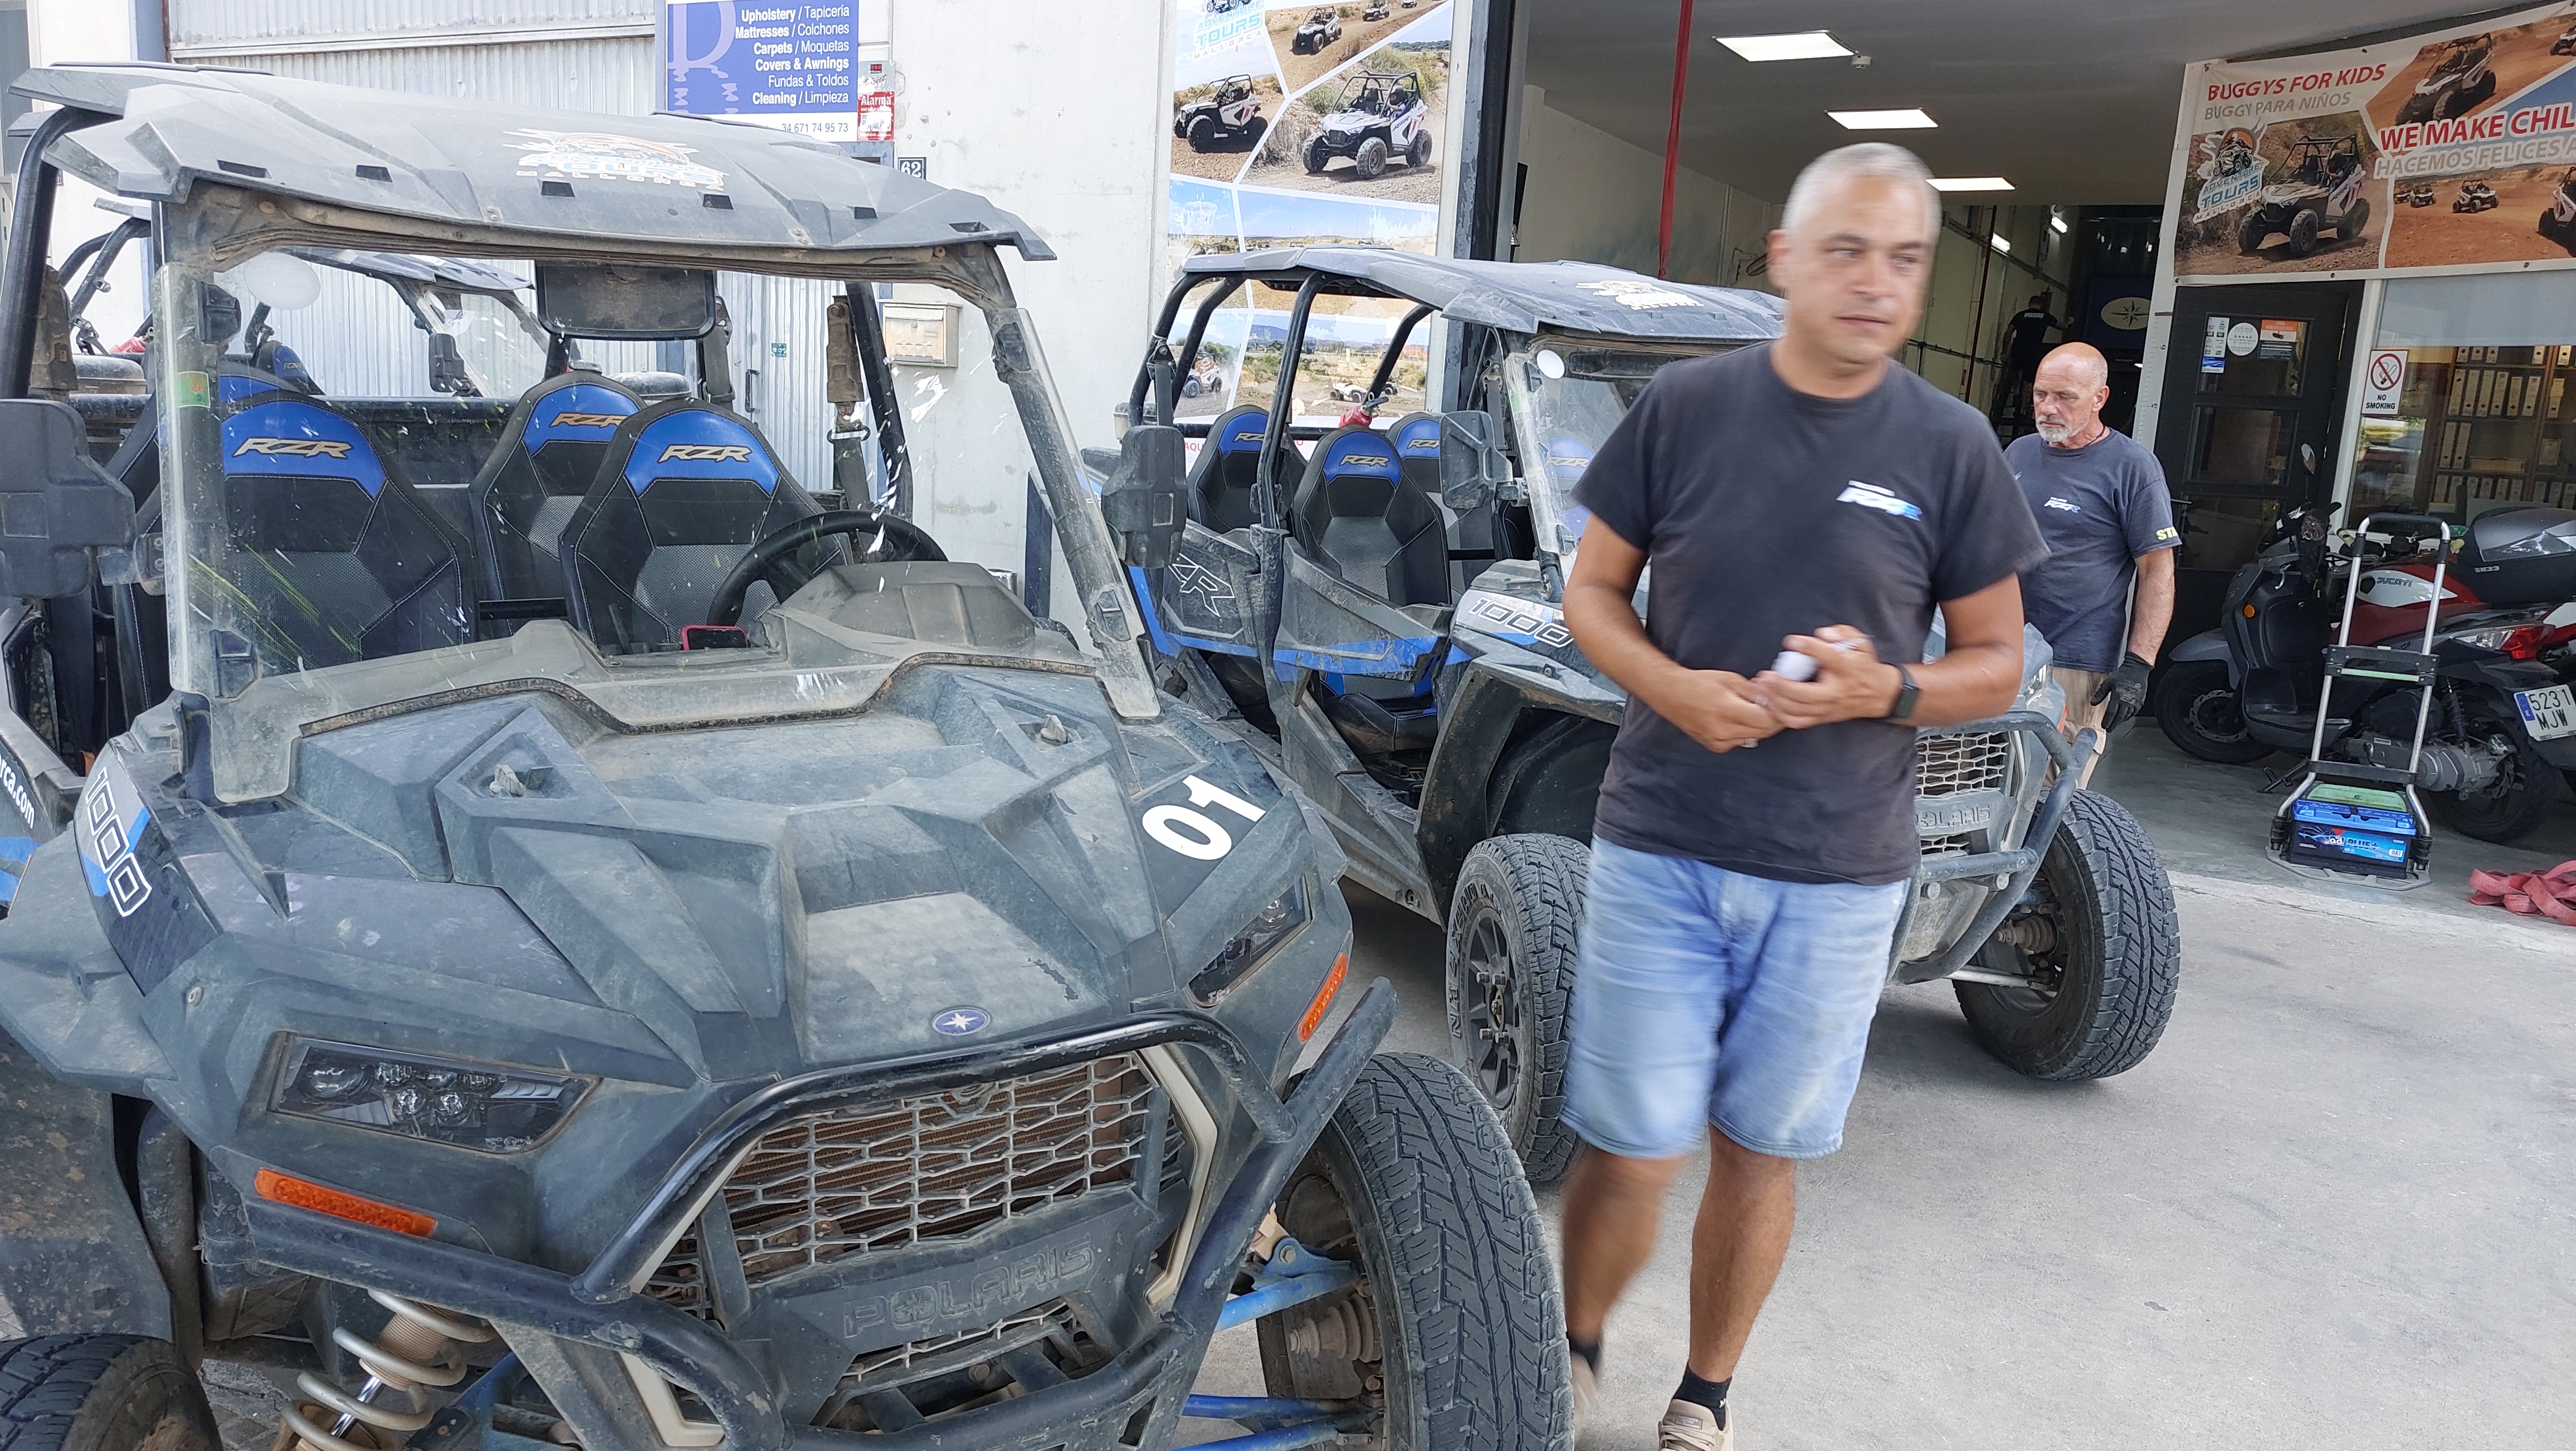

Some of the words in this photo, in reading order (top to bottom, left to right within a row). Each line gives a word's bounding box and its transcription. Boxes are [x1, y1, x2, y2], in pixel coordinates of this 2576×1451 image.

[741, 7, 796, 25] Upholstery
[798, 5, 803, 21] /
[804, 3, 850, 21] Tapicería
[735, 27, 789, 39] Mattresses
[792, 23, 796, 37] /
[798, 23, 850, 36] Colchones
[1197, 12, 1263, 48] TOURS
[754, 41, 793, 57] Carpets
[795, 40, 799, 55] /
[801, 40, 850, 55] Moquetas
[1194, 30, 1261, 60] MALLORCA
[755, 59, 791, 71] Covers
[793, 57, 802, 70] &
[804, 56, 849, 72] Awnings
[768, 74, 804, 88] Fundas
[806, 74, 814, 87] &
[816, 73, 849, 87] Toldos
[2208, 78, 2286, 101] BUGGYS
[2289, 72, 2333, 92] FOR
[2335, 64, 2387, 87] KIDS
[753, 91, 797, 107] Cleaning
[798, 90, 803, 105] /
[805, 90, 849, 106] Limpieza
[861, 94, 891, 106] Alarma
[2204, 103, 2252, 120] BUGGY
[2256, 99, 2294, 116] PARA
[2299, 91, 2351, 111] NIÑOS
[794, 123, 808, 133] 671
[812, 123, 822, 133] 74
[825, 123, 835, 133] 95
[838, 123, 848, 133] 73
[2380, 126, 2419, 150] WE
[2425, 114, 2505, 145] MAKE
[2511, 105, 2575, 134] CHIL
[2376, 150, 2473, 176] HACEMOS
[2479, 139, 2560, 165] FELICES
[901, 160, 922, 178] 62
[2203, 162, 2262, 193] ADVENTURE
[516, 170, 725, 192] MALLORCA
[2201, 174, 2260, 210] TOURS
[2196, 192, 2261, 221] MALLORCA
[550, 412, 628, 429] RZR
[232, 437, 354, 459] RZR
[1233, 432, 1265, 442] RZ
[1406, 439, 1440, 449] RZ
[657, 444, 753, 464] RZR
[1339, 454, 1390, 467] RZR
[1544, 456, 1591, 468] RZR
[1468, 597, 1574, 648] 1000
[2529, 688, 2571, 711] 5231
[2535, 708, 2568, 731] MJW
[0, 753, 35, 830] rca.com
[1142, 775, 1267, 860] 01
[1915, 804, 1990, 829] OLARIS
[85, 766, 153, 918] 1000
[843, 1231, 1095, 1339] POLARIS
